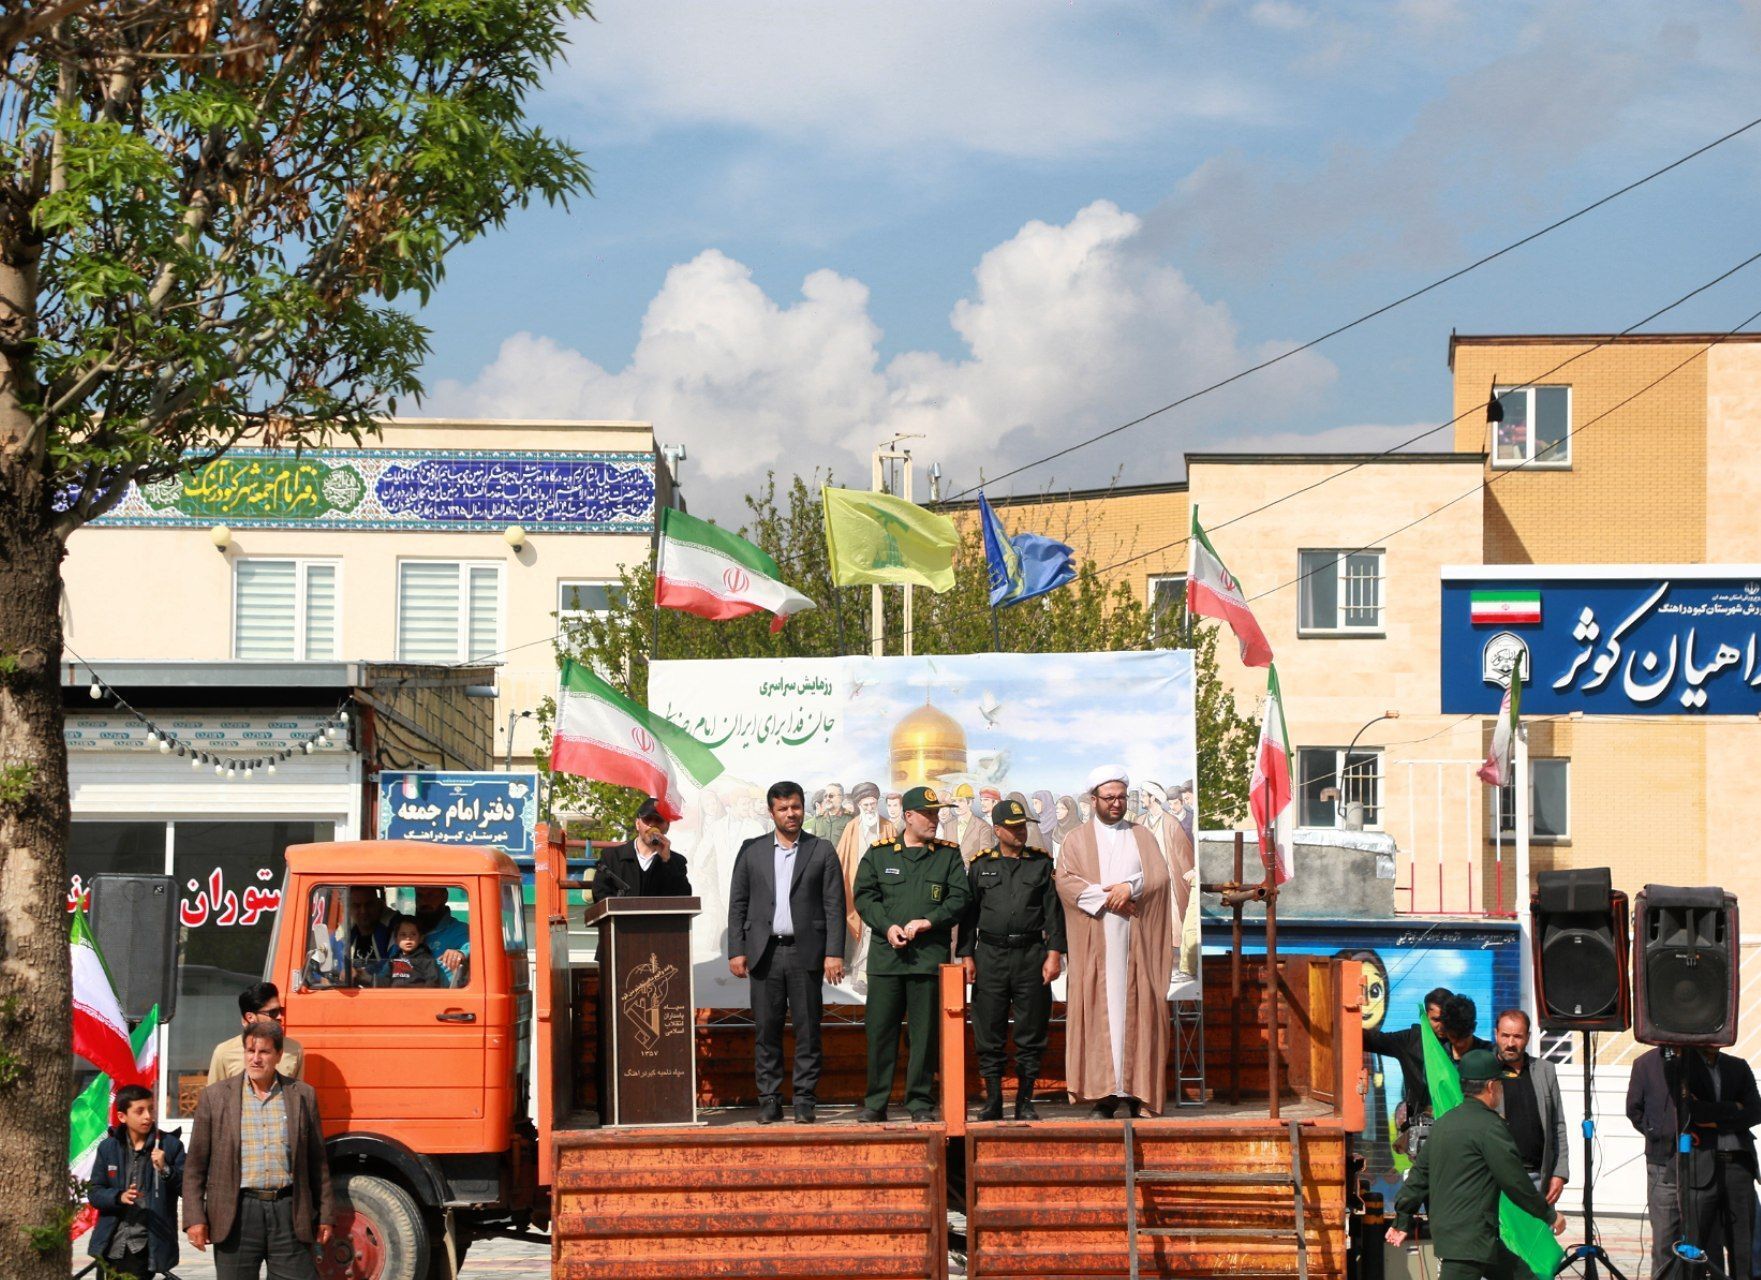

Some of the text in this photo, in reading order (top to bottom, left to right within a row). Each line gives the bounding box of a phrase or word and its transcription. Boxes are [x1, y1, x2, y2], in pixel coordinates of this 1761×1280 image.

[228, 462, 261, 508] شهر
[246, 467, 275, 512] جمعه
[272, 470, 299, 509] امام
[286, 464, 318, 512] دفتر
[1706, 603, 1743, 616] شهرستان
[1552, 581, 1669, 690] کوثر
[759, 675, 833, 698] رزمایش سراسری
[693, 714, 716, 738] امام
[697, 712, 757, 750] ایران
[757, 712, 787, 746] برای
[781, 710, 835, 747] جان
[787, 706, 804, 734] فدا
[397, 797, 516, 829] دفتر امام جمعه
[403, 830, 509, 843] شهرستان کبودراهنگ
